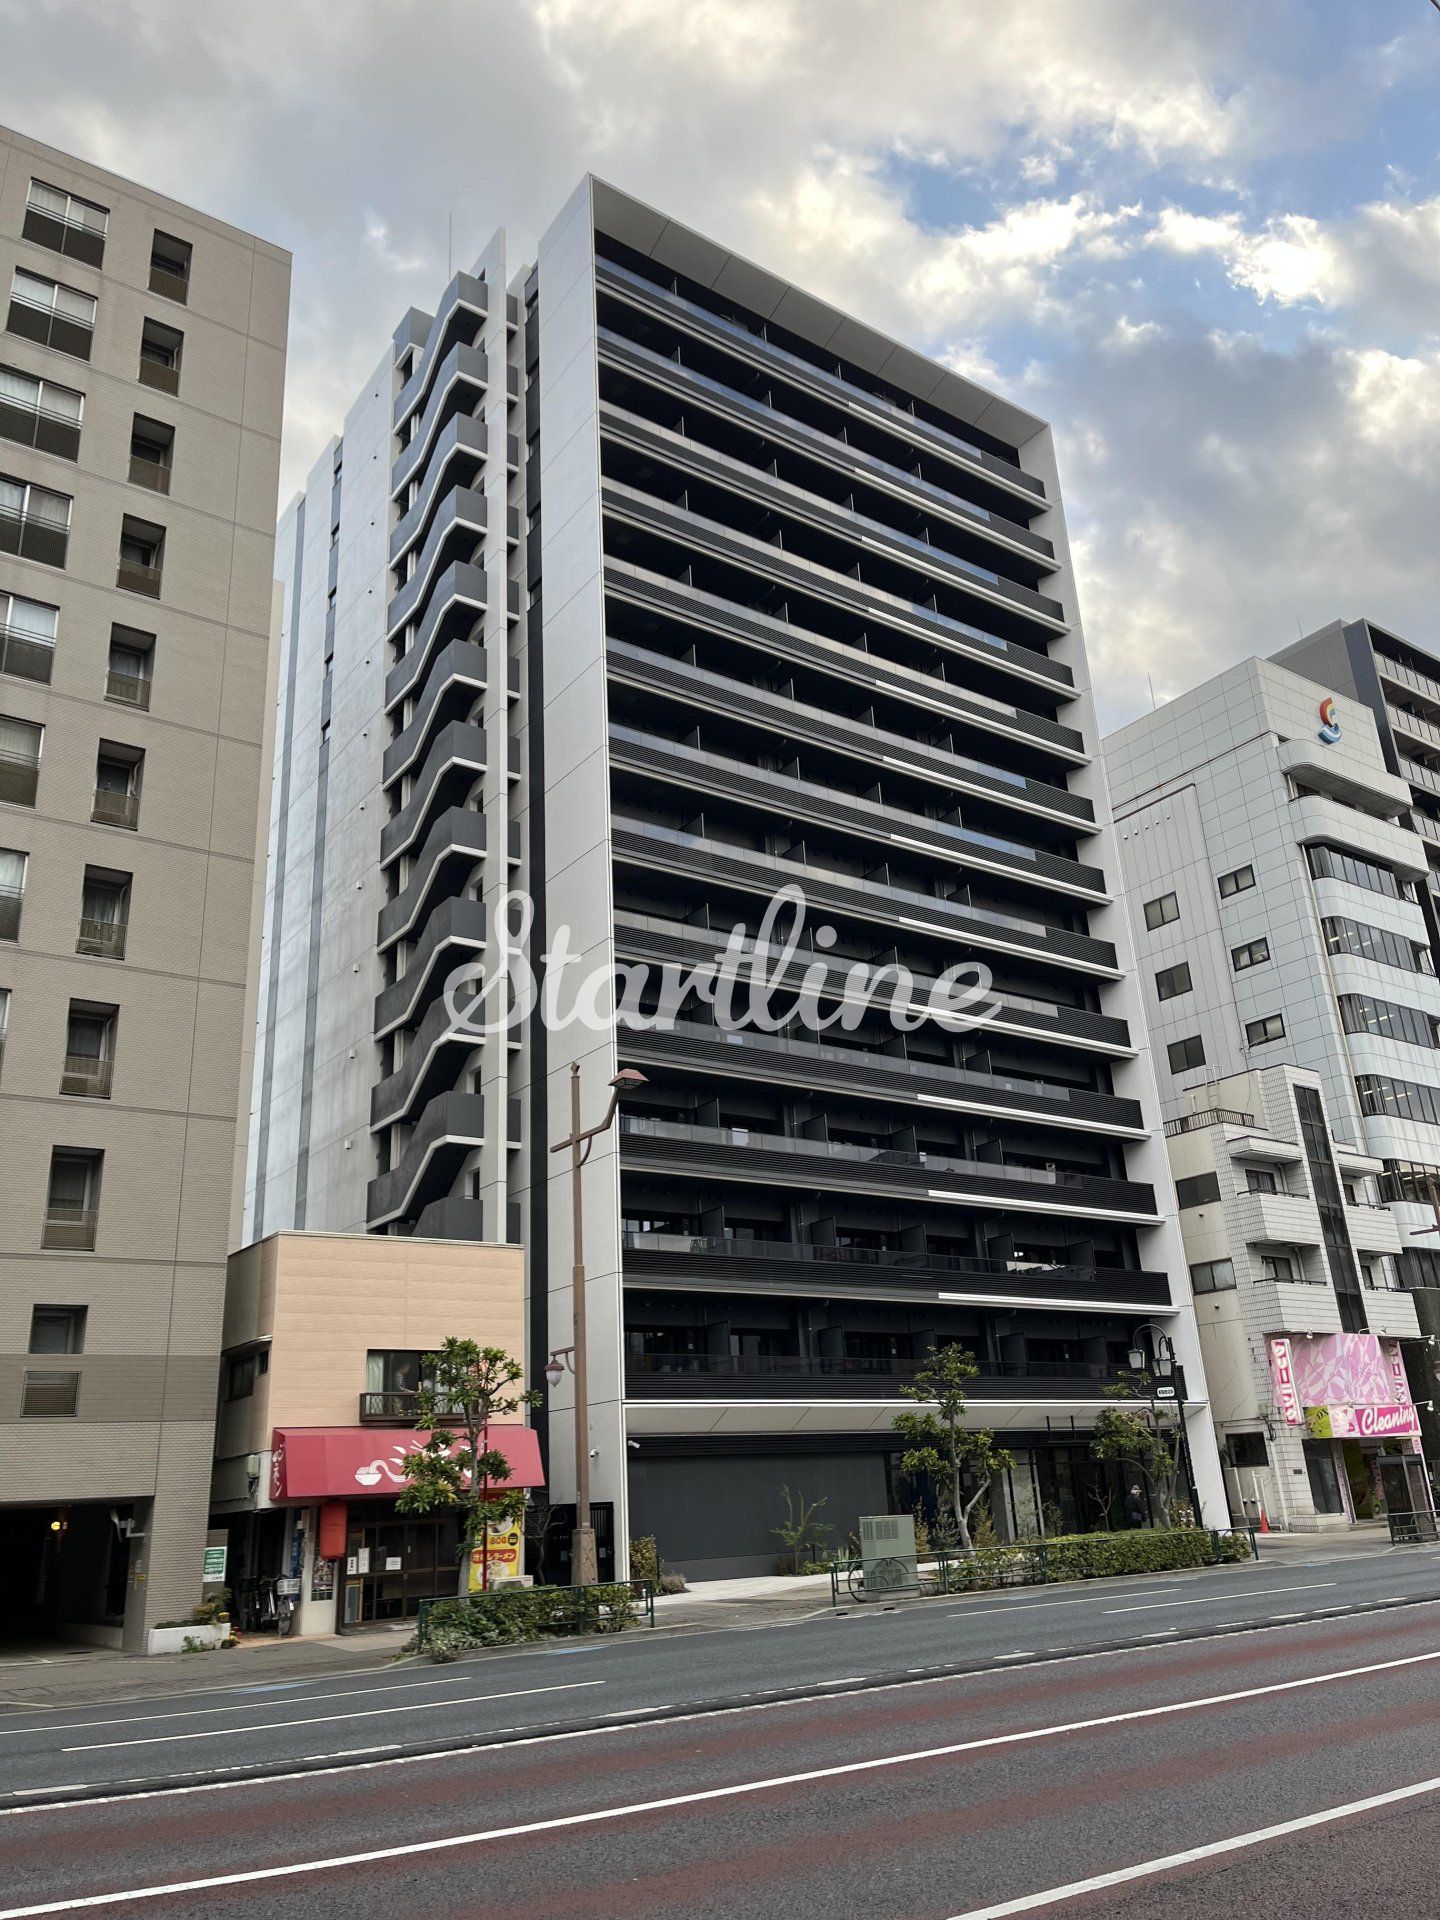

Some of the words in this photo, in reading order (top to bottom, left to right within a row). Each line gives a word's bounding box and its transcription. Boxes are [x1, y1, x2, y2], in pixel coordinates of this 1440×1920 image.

[1274, 1343, 1297, 1420] クリーニング
[1361, 1405, 1415, 1434] Cleaning
